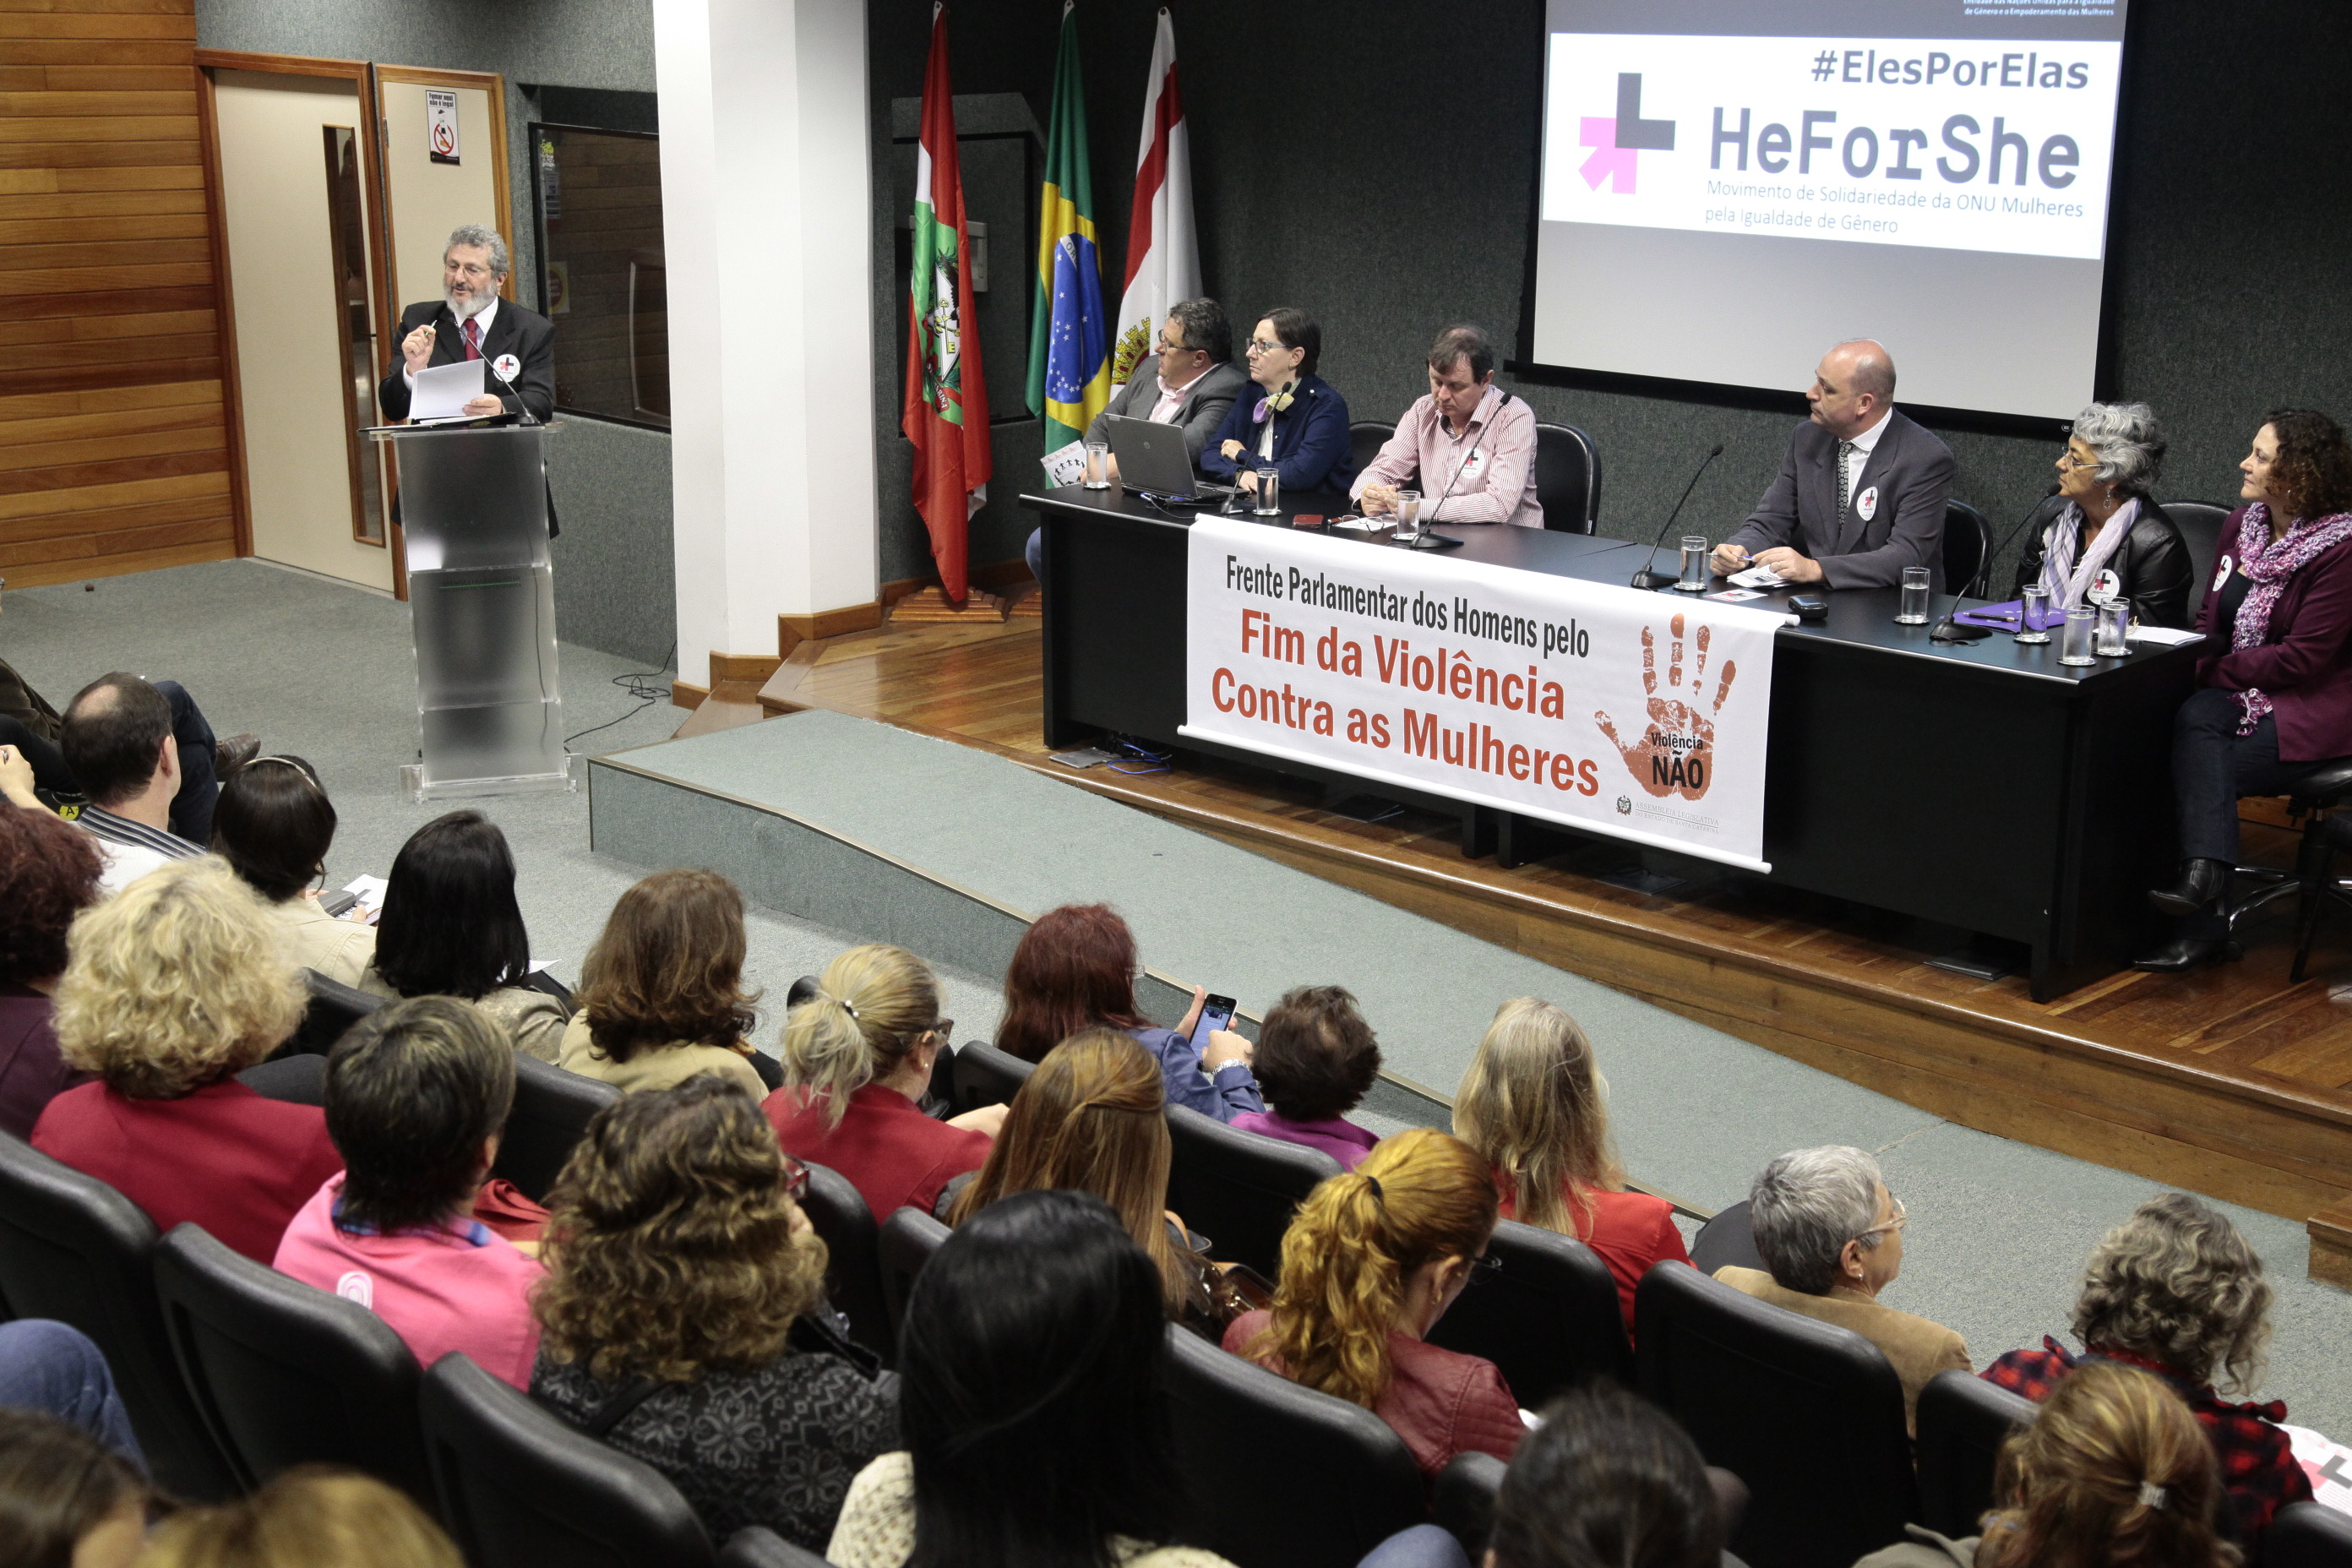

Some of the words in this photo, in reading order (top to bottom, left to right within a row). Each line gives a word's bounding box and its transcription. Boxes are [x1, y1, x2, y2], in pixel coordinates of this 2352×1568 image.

[2010, 8, 2066, 17] Empoderamento
[1811, 49, 2089, 90] #ElesPorElas
[1710, 106, 2080, 189] HeForShe
[1707, 180, 1791, 199] Movimento
[1797, 184, 1815, 200] de
[1820, 186, 1926, 207] Solidariedade
[1932, 192, 1951, 209] da
[1957, 194, 1995, 211] ONU
[2002, 196, 2083, 217] Mulheres
[1705, 206, 1735, 224] pela
[1740, 209, 1812, 227] Igualdade
[1817, 212, 1836, 229] de
[1841, 214, 1898, 233] Gênero
[1227, 554, 1283, 599] Frente
[1288, 566, 1408, 623] Parlamentar
[1412, 591, 1448, 631] dos
[1454, 596, 1538, 648] Homens
[1544, 618, 1589, 660] pelo
[1242, 608, 1304, 665] Fim
[1316, 626, 1362, 678] da
[1374, 634, 1564, 720] Violência
[1211, 667, 1333, 737] Contra
[1347, 708, 1391, 749] as
[1403, 707, 1598, 797] Mulheres
[1651, 732, 1703, 749] Violência
[1652, 750, 1704, 789] NÃO
[1635, 802, 1676, 816] ASSEMBLEIA
[1678, 810, 1719, 826] LEGISLATIVA
[1644, 814, 1665, 822] ESTADO
[1675, 820, 1691, 829] SANTA
[1692, 825, 1719, 835] CATARINA
